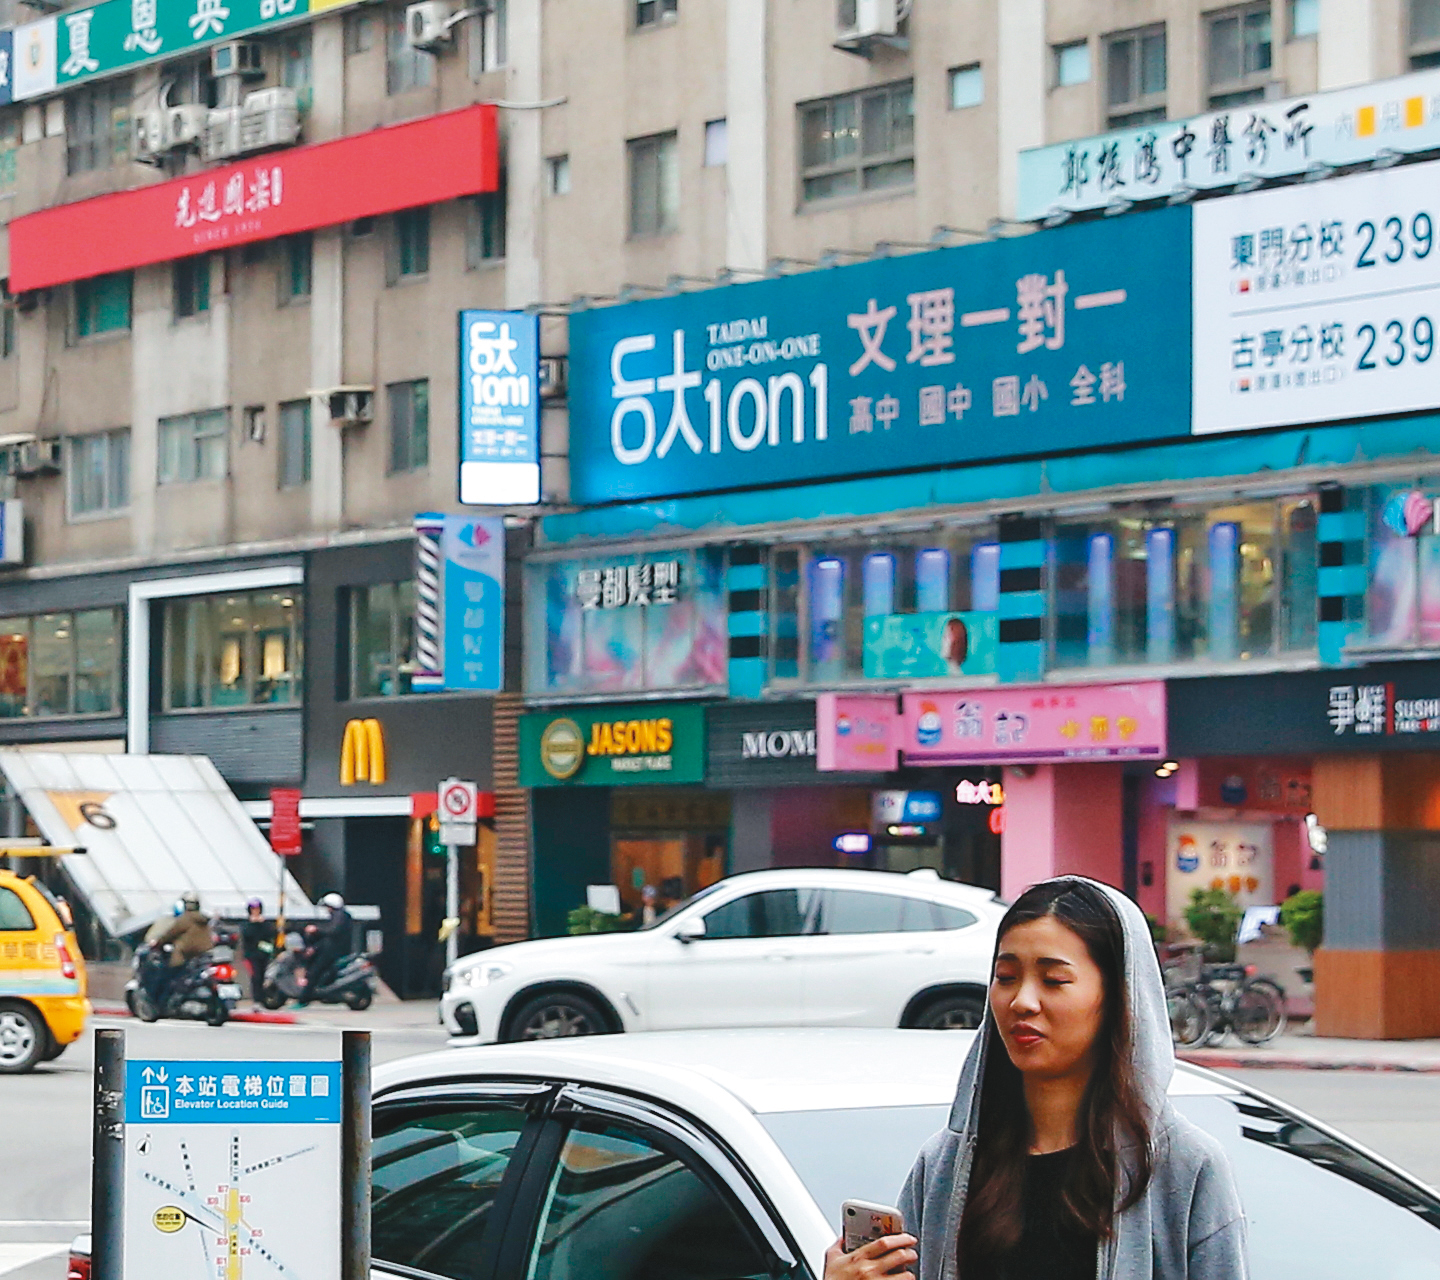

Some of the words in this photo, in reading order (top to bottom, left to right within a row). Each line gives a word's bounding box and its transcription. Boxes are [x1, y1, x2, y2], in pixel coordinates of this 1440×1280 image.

[1230, 221, 1343, 270] 東門分校
[846, 268, 1127, 377] 文理一對一
[1231, 322, 1344, 368] 古亭分校
[918, 383, 972, 427] 國中
[991, 374, 1049, 417] 國小
[1069, 361, 1127, 409] 全科
[576, 560, 681, 609] 曼都髮型
[586, 717, 673, 756] JASONS
[175, 1074, 329, 1097] 本站電梯位置圖
[175, 1098, 214, 1109] Elevator
[217, 1098, 259, 1109] Location
[261, 1098, 289, 1109] Guide
